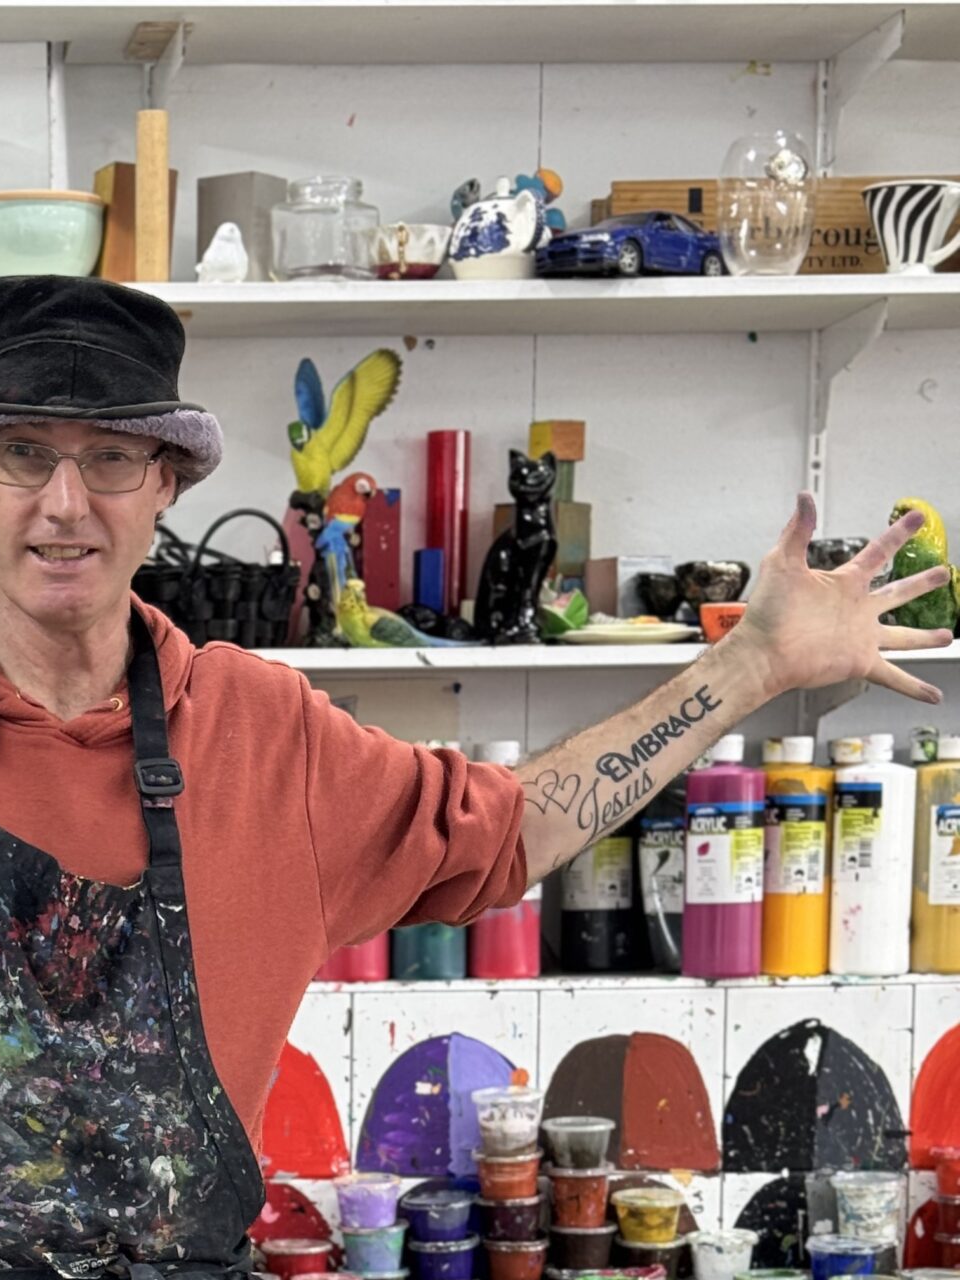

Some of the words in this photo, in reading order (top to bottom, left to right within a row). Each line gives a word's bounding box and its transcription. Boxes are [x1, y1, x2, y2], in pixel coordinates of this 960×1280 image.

[596, 685, 723, 782] EMBRACE
[577, 768, 656, 842] Jesus
[690, 816, 728, 832] ACRYLIC
